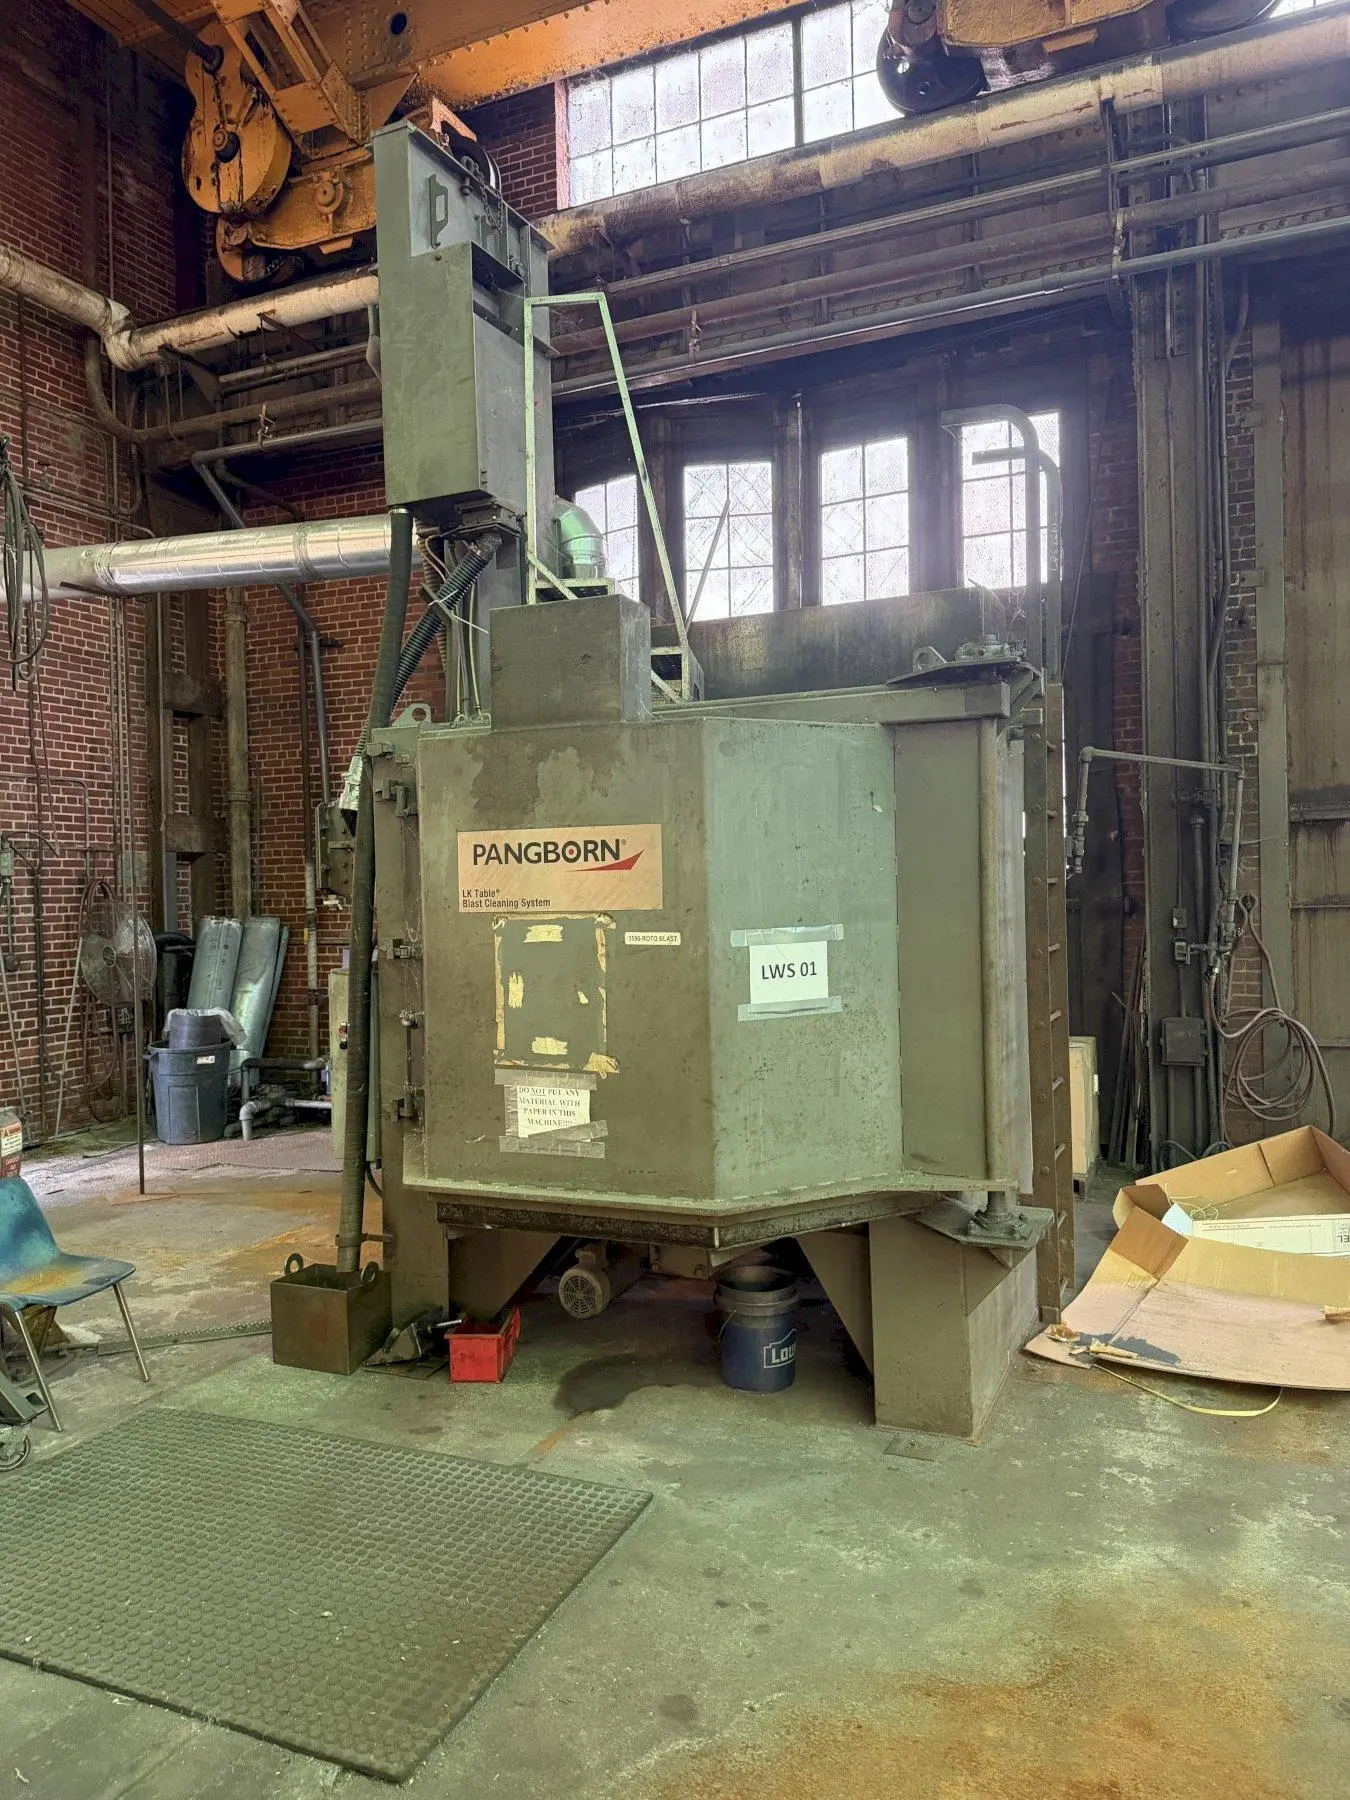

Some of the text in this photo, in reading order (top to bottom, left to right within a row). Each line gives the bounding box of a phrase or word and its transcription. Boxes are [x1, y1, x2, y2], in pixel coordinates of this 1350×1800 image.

[462, 889, 472, 898] LK
[462, 898, 551, 909] Blast Cleaning System
[761, 961, 817, 980] LWS 01
[518, 1086, 530, 1094] DO
[531, 1087, 546, 1096] NOT
[564, 1089, 580, 1097] ANY
[518, 1097, 581, 1107] MATERIAL WITH
[523, 1107, 576, 1117] PAPER IN THIS
